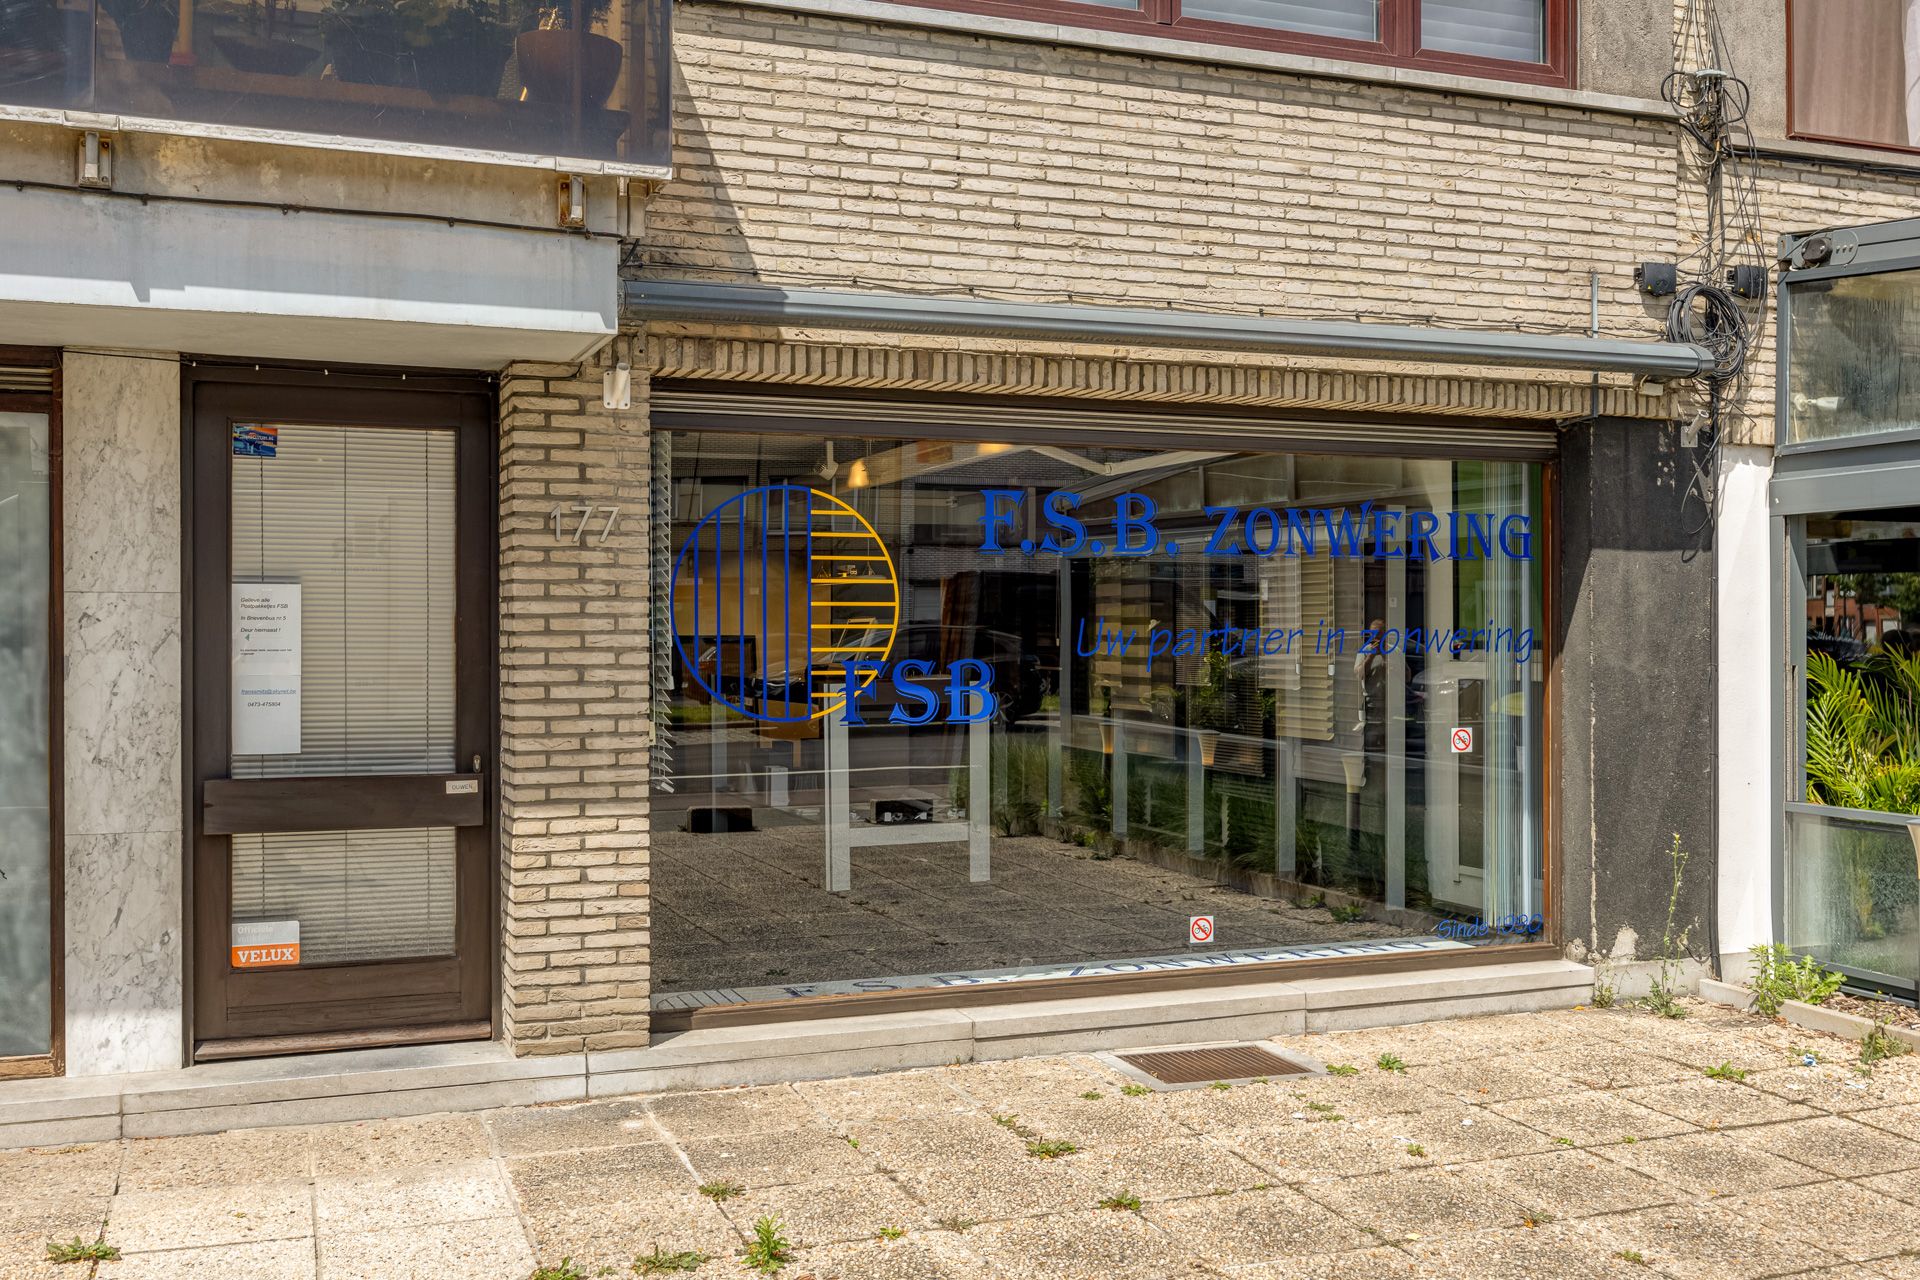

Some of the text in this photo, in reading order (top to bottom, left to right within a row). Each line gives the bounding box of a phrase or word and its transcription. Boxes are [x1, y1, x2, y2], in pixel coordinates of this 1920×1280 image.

[549, 504, 621, 544] 177
[978, 489, 1536, 564] F.S.B. ZONWERING
[1077, 617, 1535, 673] Uw partner in zonwering
[837, 658, 1000, 727] FSB
[237, 947, 294, 963] VELUX
